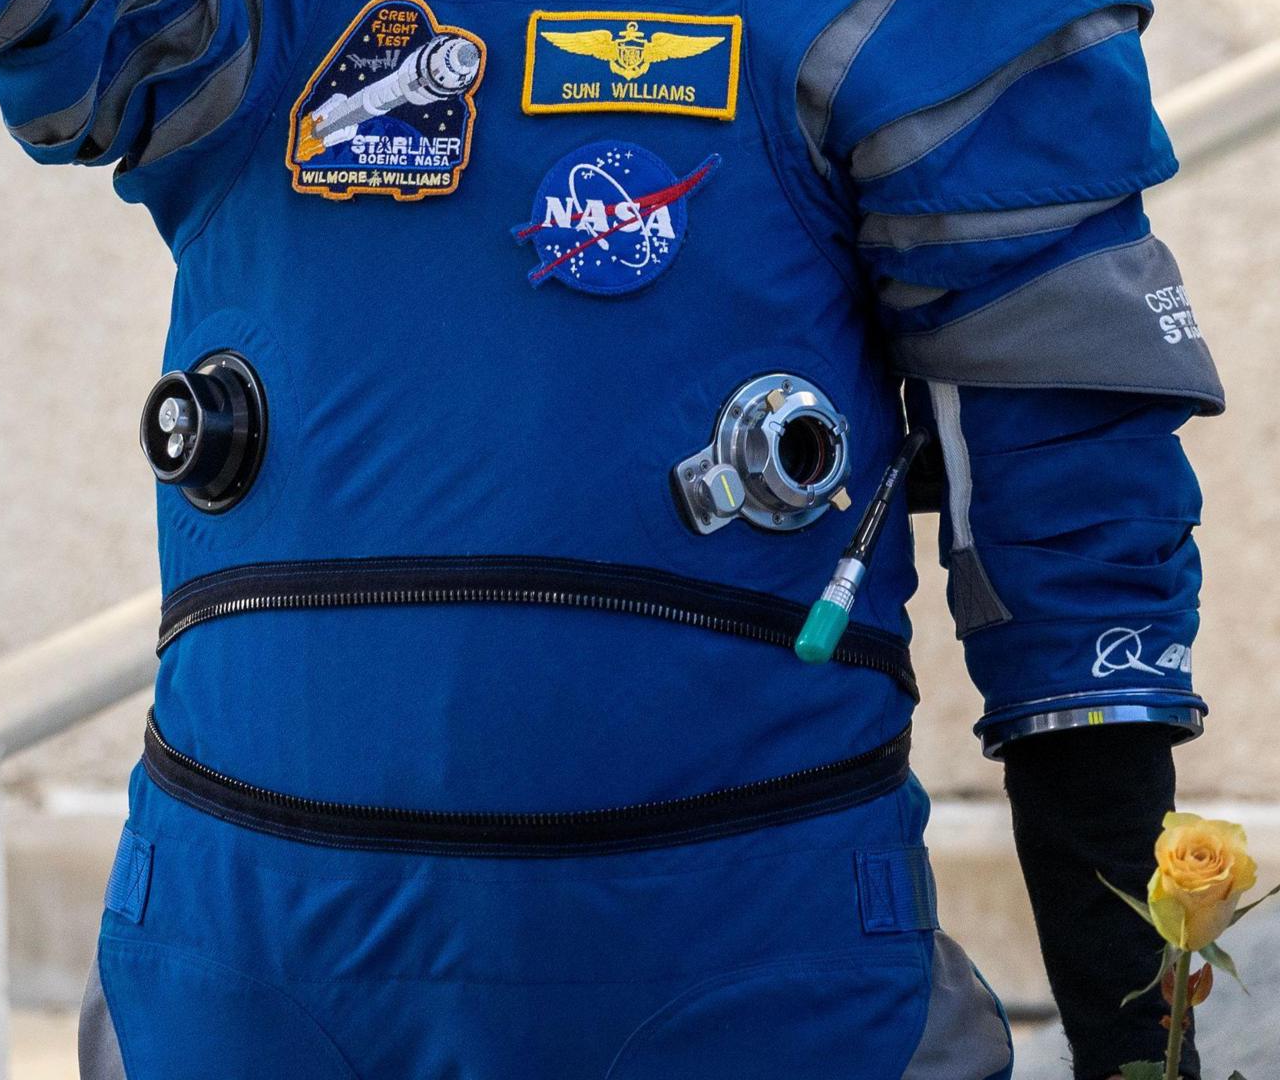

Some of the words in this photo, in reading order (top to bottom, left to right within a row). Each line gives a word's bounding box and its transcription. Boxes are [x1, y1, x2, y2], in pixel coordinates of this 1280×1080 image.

[378, 8, 418, 21] CREW
[371, 20, 419, 35] FLIGHT
[375, 34, 410, 47] TEST
[562, 81, 600, 99] SUNI
[611, 81, 696, 102] WILLIAMS
[351, 134, 461, 156] STARLINER
[358, 153, 408, 166] BOEING
[415, 154, 450, 167] NASA
[301, 170, 367, 185] WILMORE
[381, 171, 451, 186] WILLIAMS
[541, 196, 675, 239] NASA
